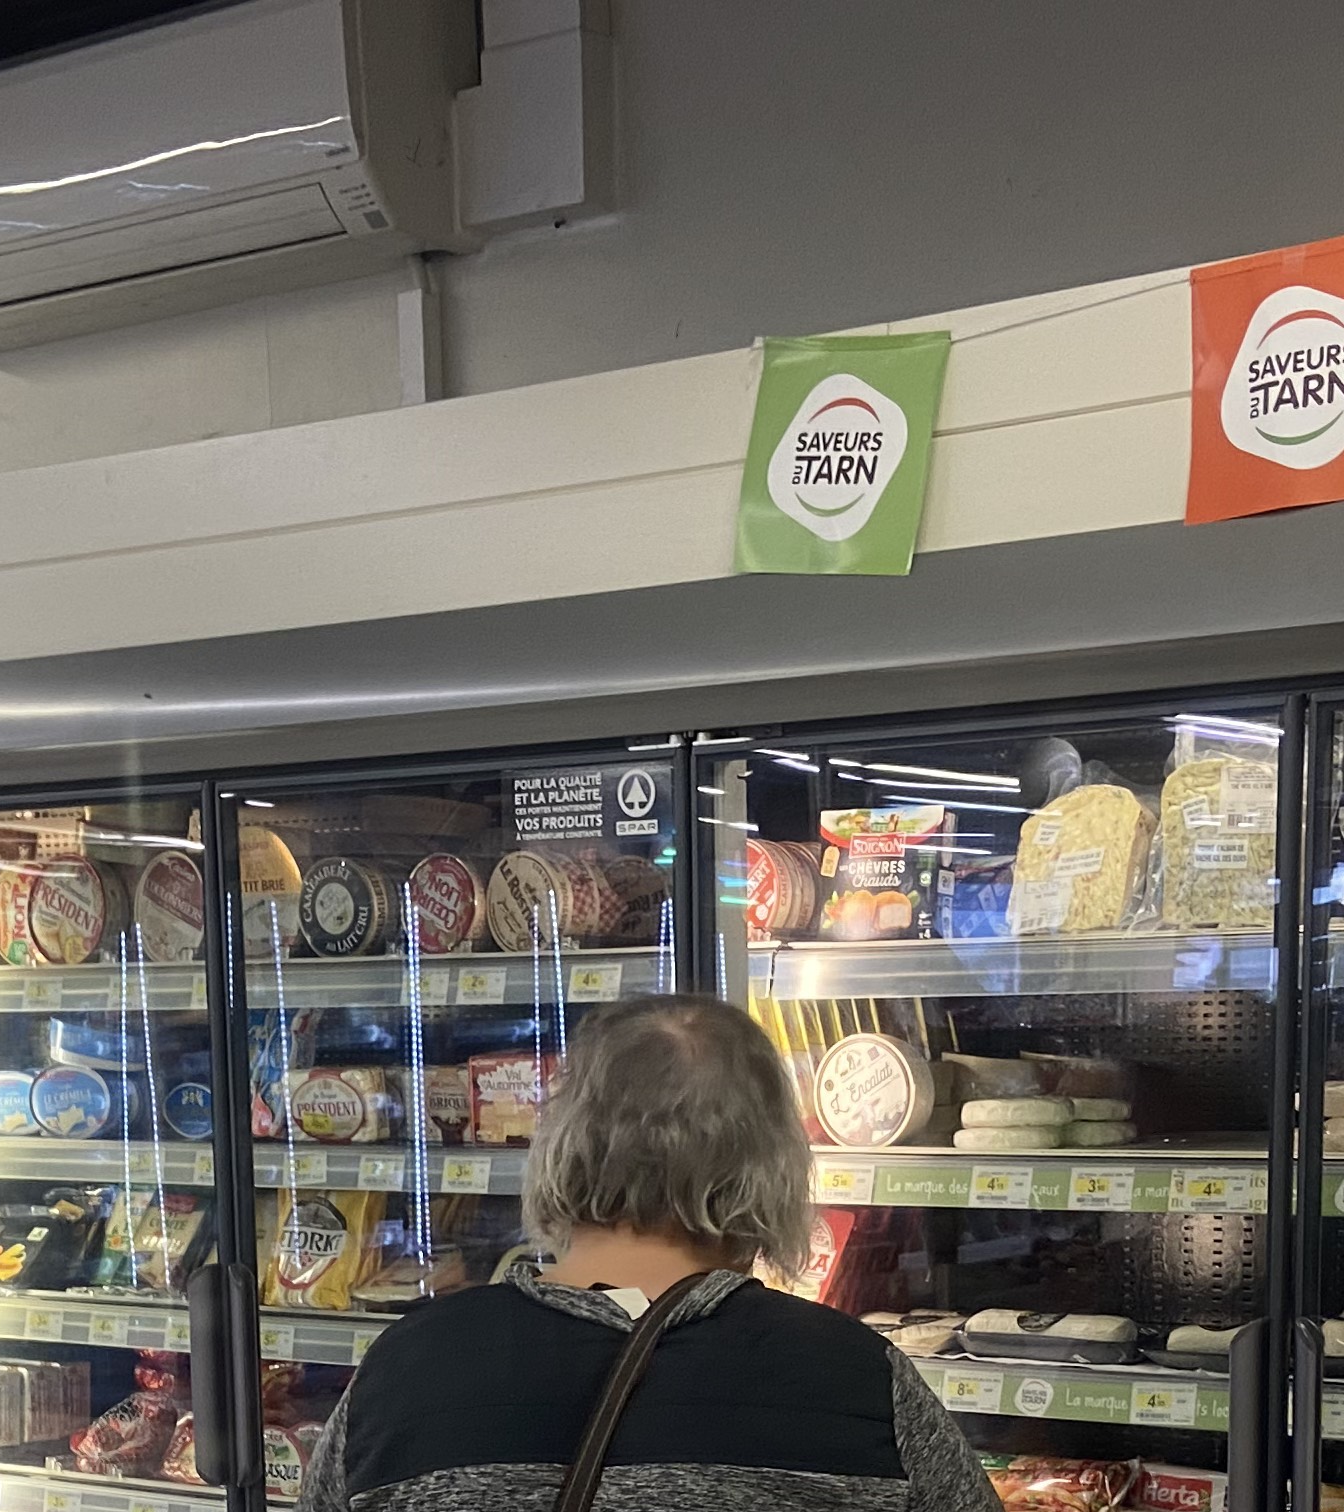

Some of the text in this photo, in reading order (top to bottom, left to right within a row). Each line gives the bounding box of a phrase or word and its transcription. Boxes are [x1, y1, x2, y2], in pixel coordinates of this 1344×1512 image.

[1249, 397, 1260, 420] DU
[795, 431, 883, 452] SAVEURS
[792, 464, 804, 485] DU
[795, 454, 879, 485] TARN
[514, 771, 602, 791] POUR LA QUALITÉ
[514, 792, 529, 805] ET
[530, 791, 550, 804] LA
[515, 814, 603, 831] VOS PRODUITS
[617, 822, 657, 833] SPAR
[848, 857, 906, 877] CHÈVRES
[260, 877, 286, 892] BRIE
[852, 873, 902, 889] Chauds
[302, 863, 352, 922] CAMEMBERT
[33, 880, 102, 935] PRÉSIDENT
[337, 905, 370, 953] LAIT CRU
[295, 1099, 359, 1120] PRÉSIDENT
[886, 1176, 969, 1199] La marque des
[1065, 1392, 1081, 1409] La
[1083, 1396, 1128, 1416] marque
